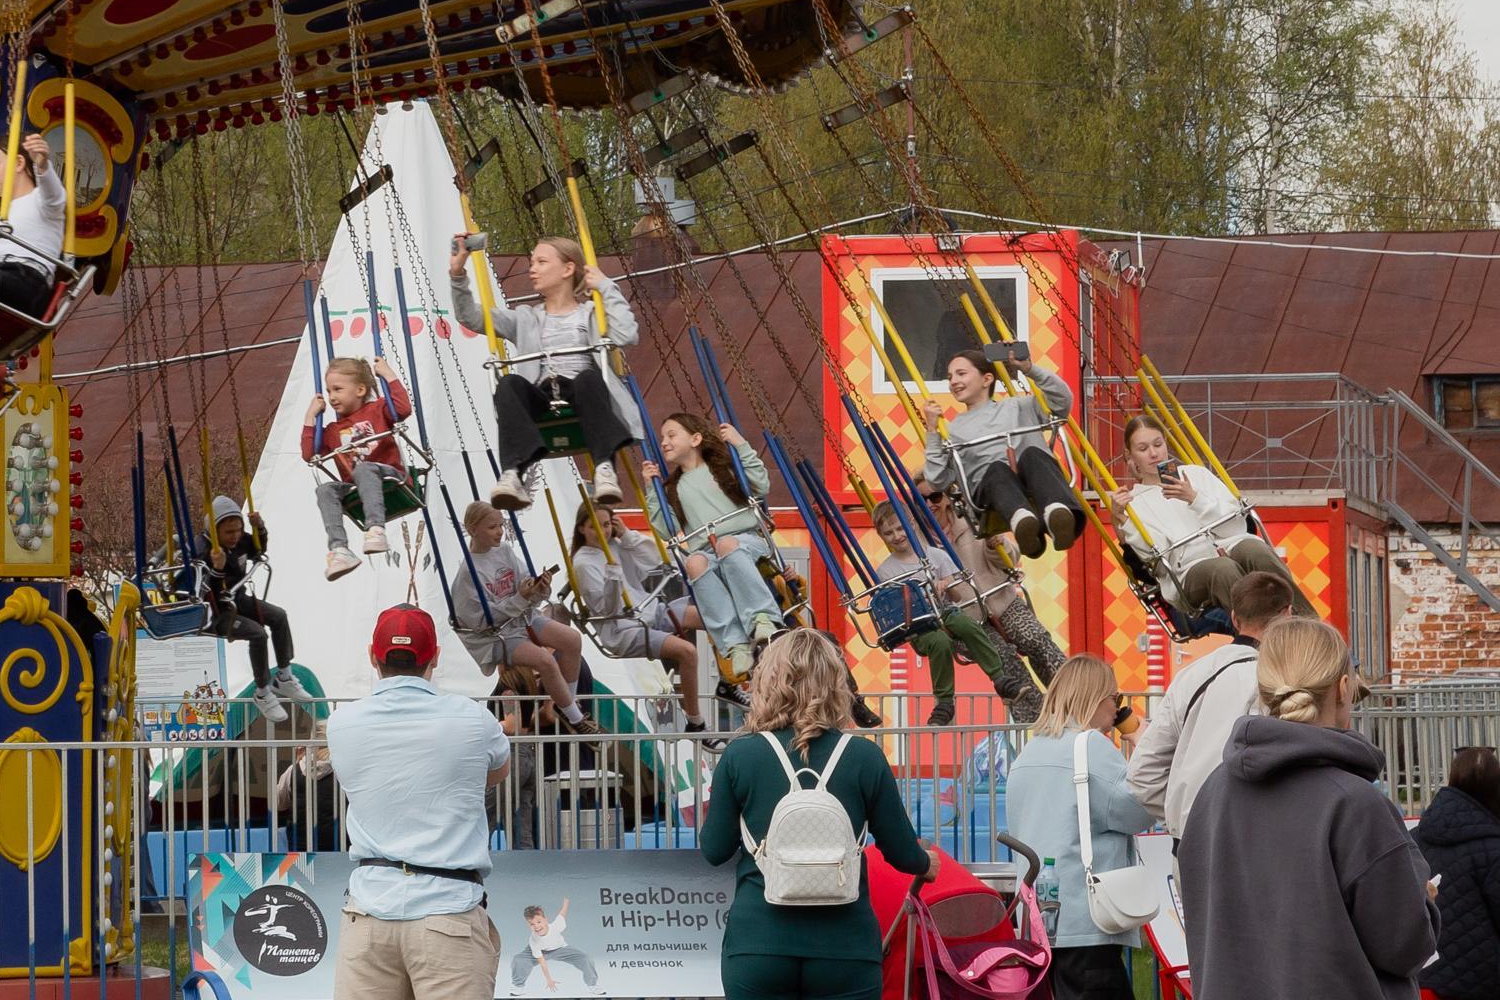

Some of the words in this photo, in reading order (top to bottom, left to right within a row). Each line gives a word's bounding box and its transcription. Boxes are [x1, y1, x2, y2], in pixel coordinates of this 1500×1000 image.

[599, 886, 728, 905] BreakDance
[602, 915, 615, 928] и
[620, 909, 709, 932] Hip-Hop
[266, 944, 317, 956] Планета
[606, 943, 630, 953] для
[633, 942, 708, 951] мальчишек
[279, 952, 321, 964] танцев
[620, 960, 684, 968] девчонок
